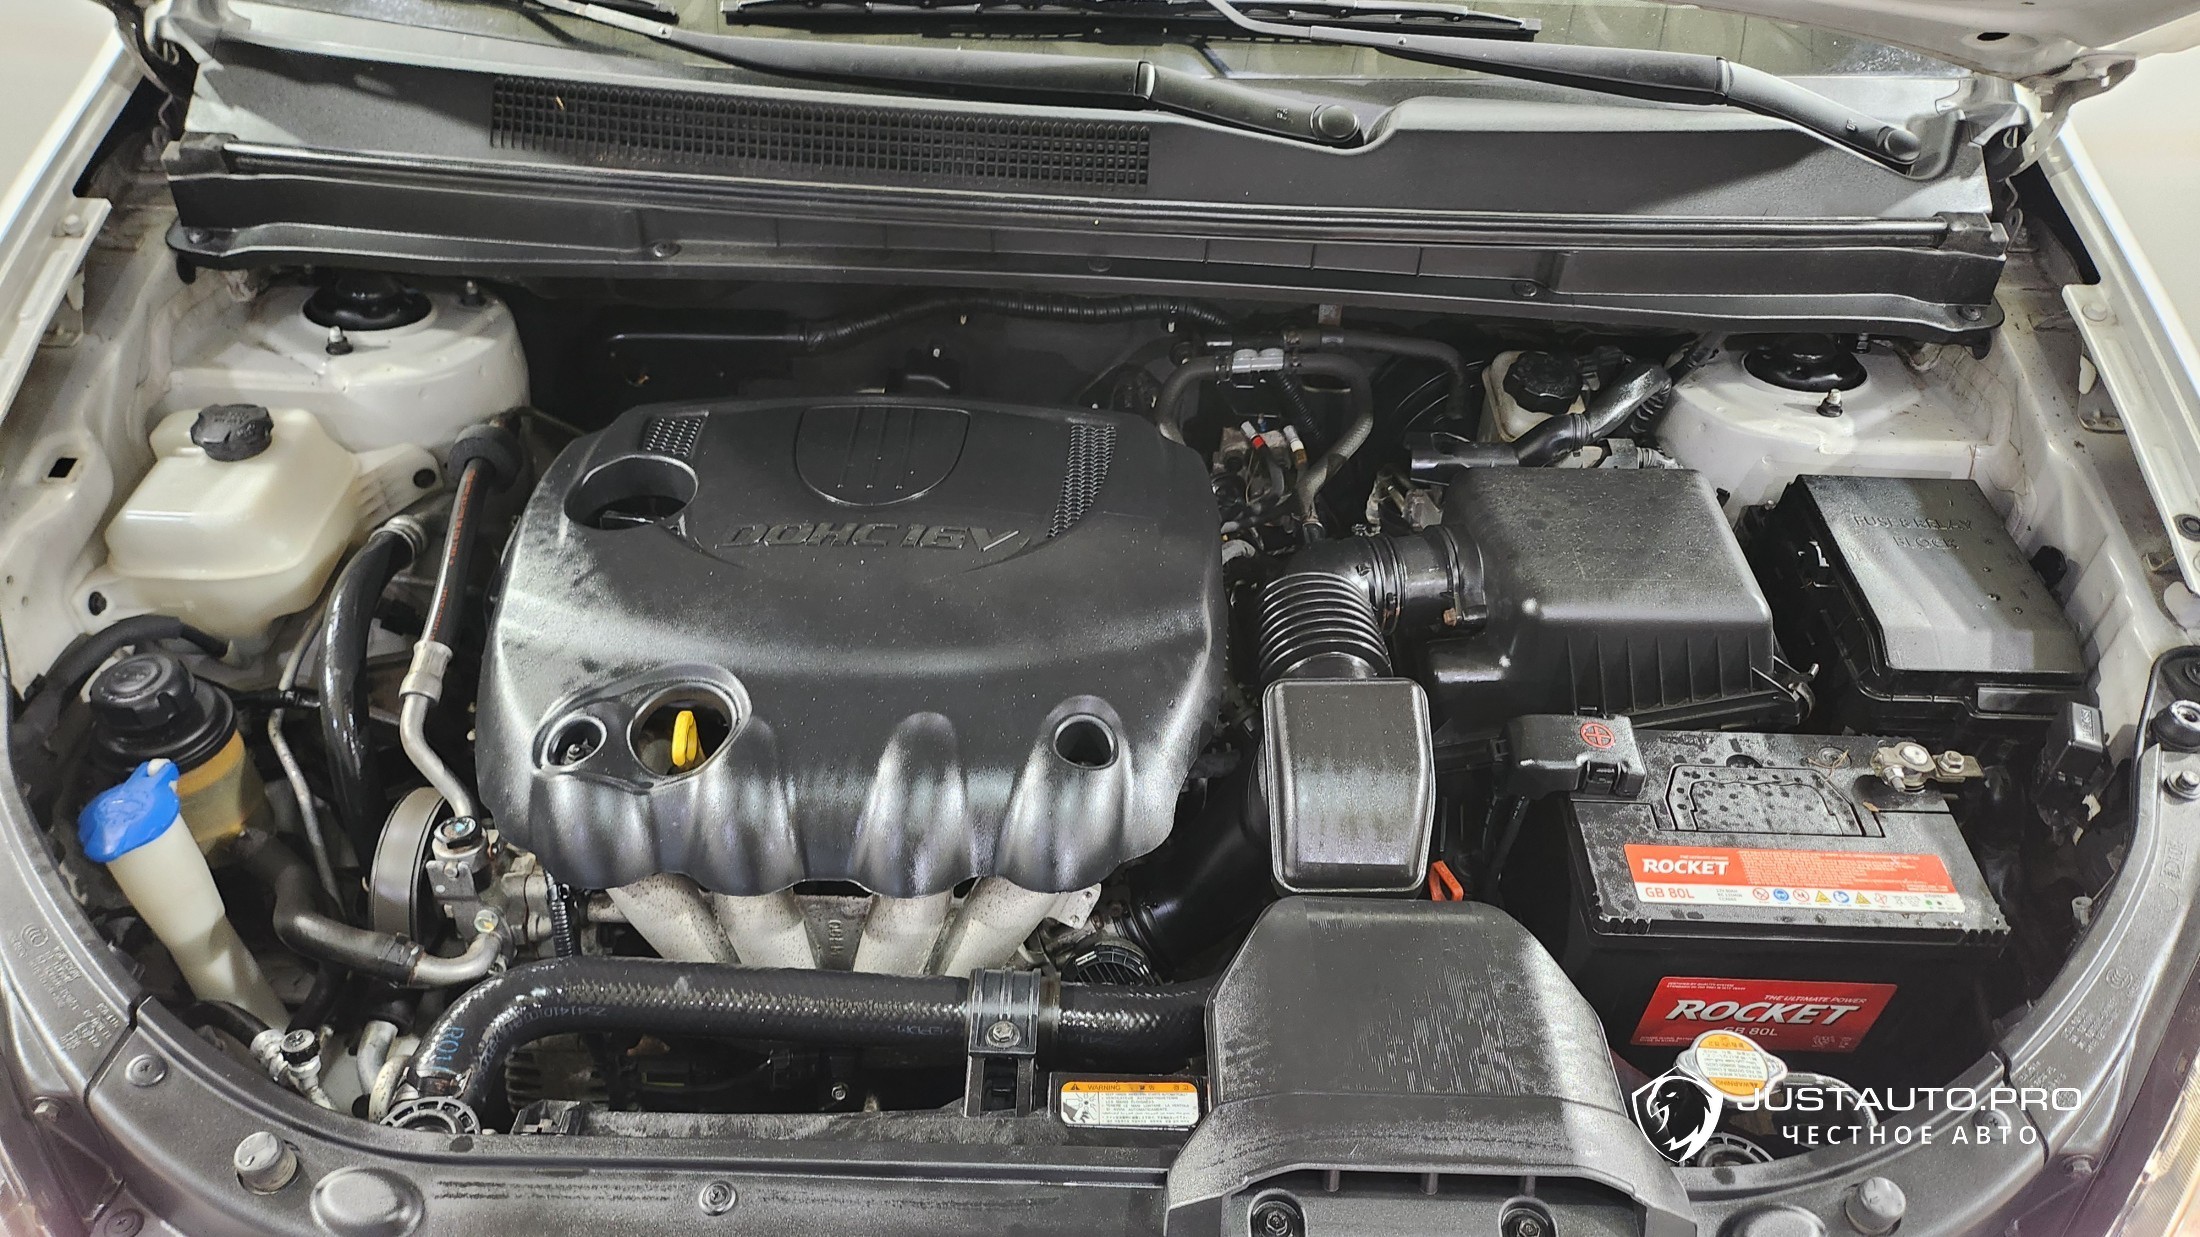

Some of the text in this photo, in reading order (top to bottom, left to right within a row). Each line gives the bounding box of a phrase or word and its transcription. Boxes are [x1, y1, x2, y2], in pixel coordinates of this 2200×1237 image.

[1854, 516, 1893, 528] FUSE
[1914, 518, 1973, 531] RELAY
[718, 523, 1026, 551] DOHC 16V
[1893, 537, 1960, 550] BLOCK
[1642, 858, 1730, 876] ROCKET
[1645, 887, 1695, 899] GB 80L
[1665, 999, 1860, 1025] ROCKET
[1748, 1027, 1778, 1036] 80L
[1716, 1079, 1750, 1087] WARNING
